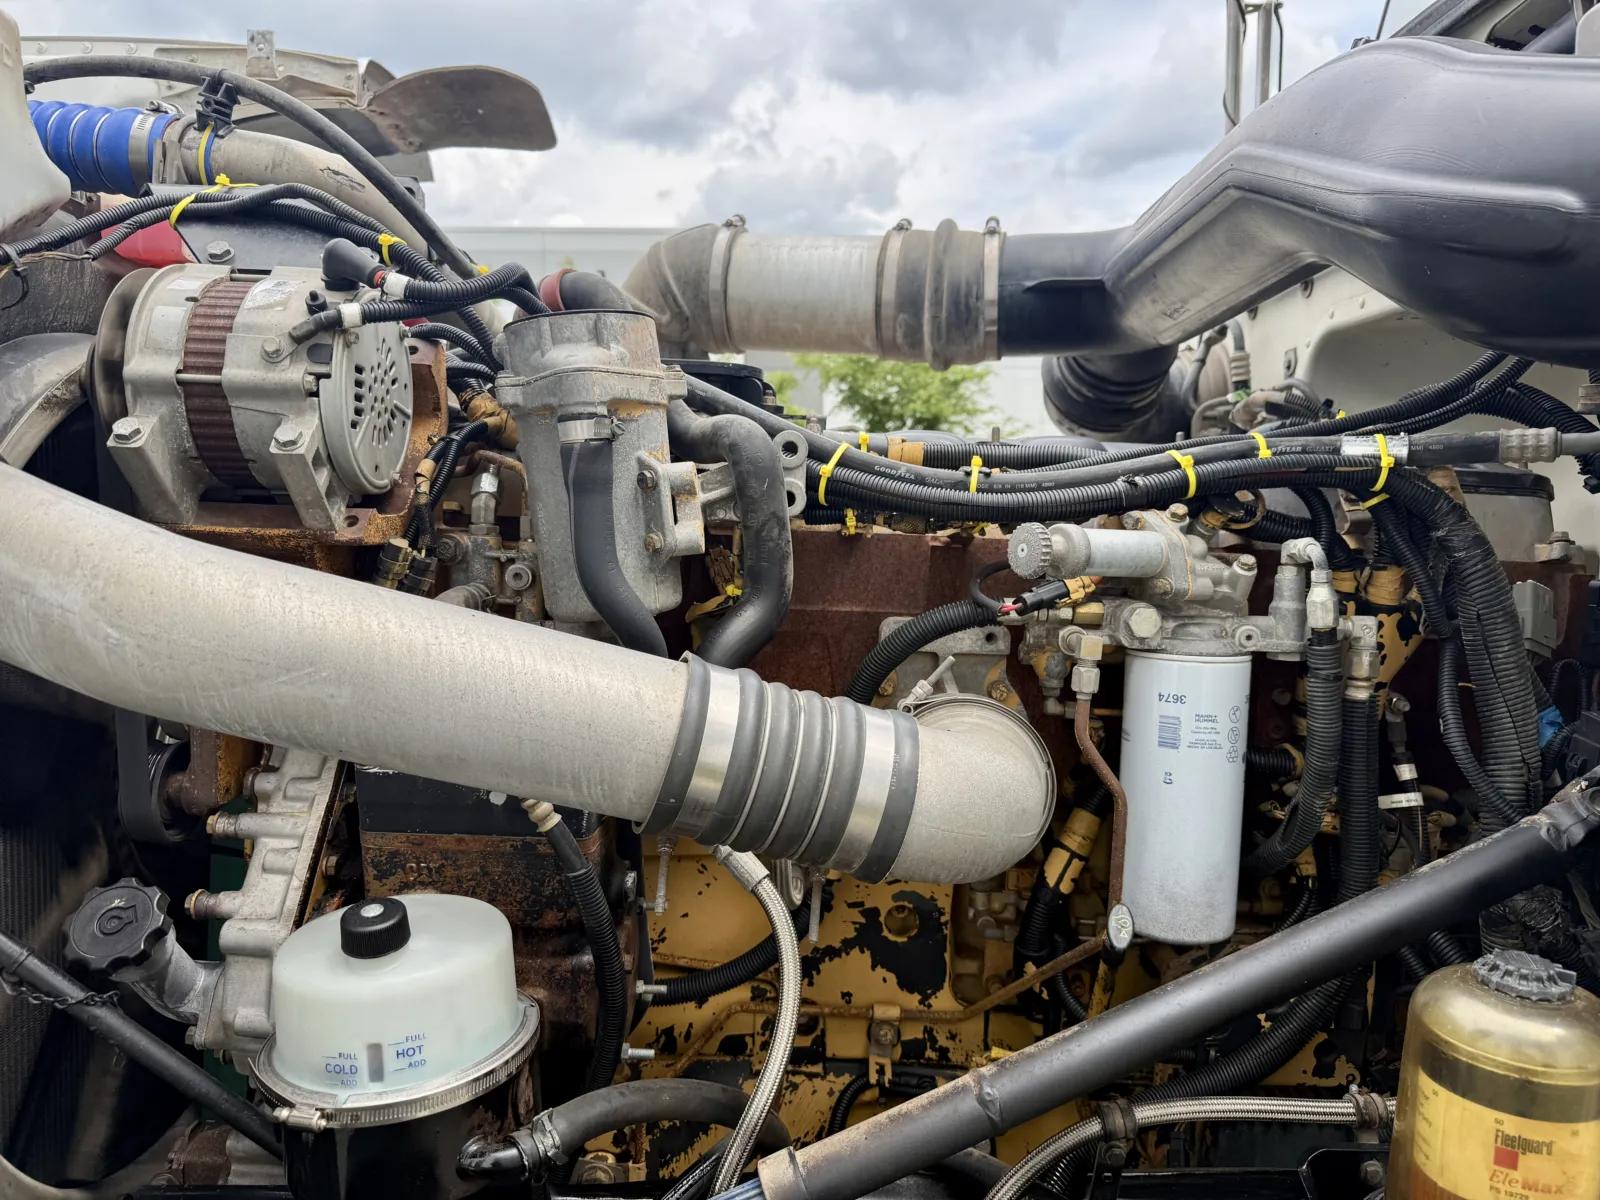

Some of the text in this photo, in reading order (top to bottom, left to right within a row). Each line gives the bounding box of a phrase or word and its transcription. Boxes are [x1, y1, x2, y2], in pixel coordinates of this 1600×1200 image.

[1158, 691, 1187, 704] 3674
[406, 1032, 427, 1043] FULL
[338, 1052, 358, 1060] FULL
[396, 1044, 424, 1060] HOT
[325, 1063, 358, 1075] COLD
[407, 1058, 427, 1069] ADD
[340, 1079, 358, 1087] ADD
[1495, 1129, 1553, 1156] Fleetguard
